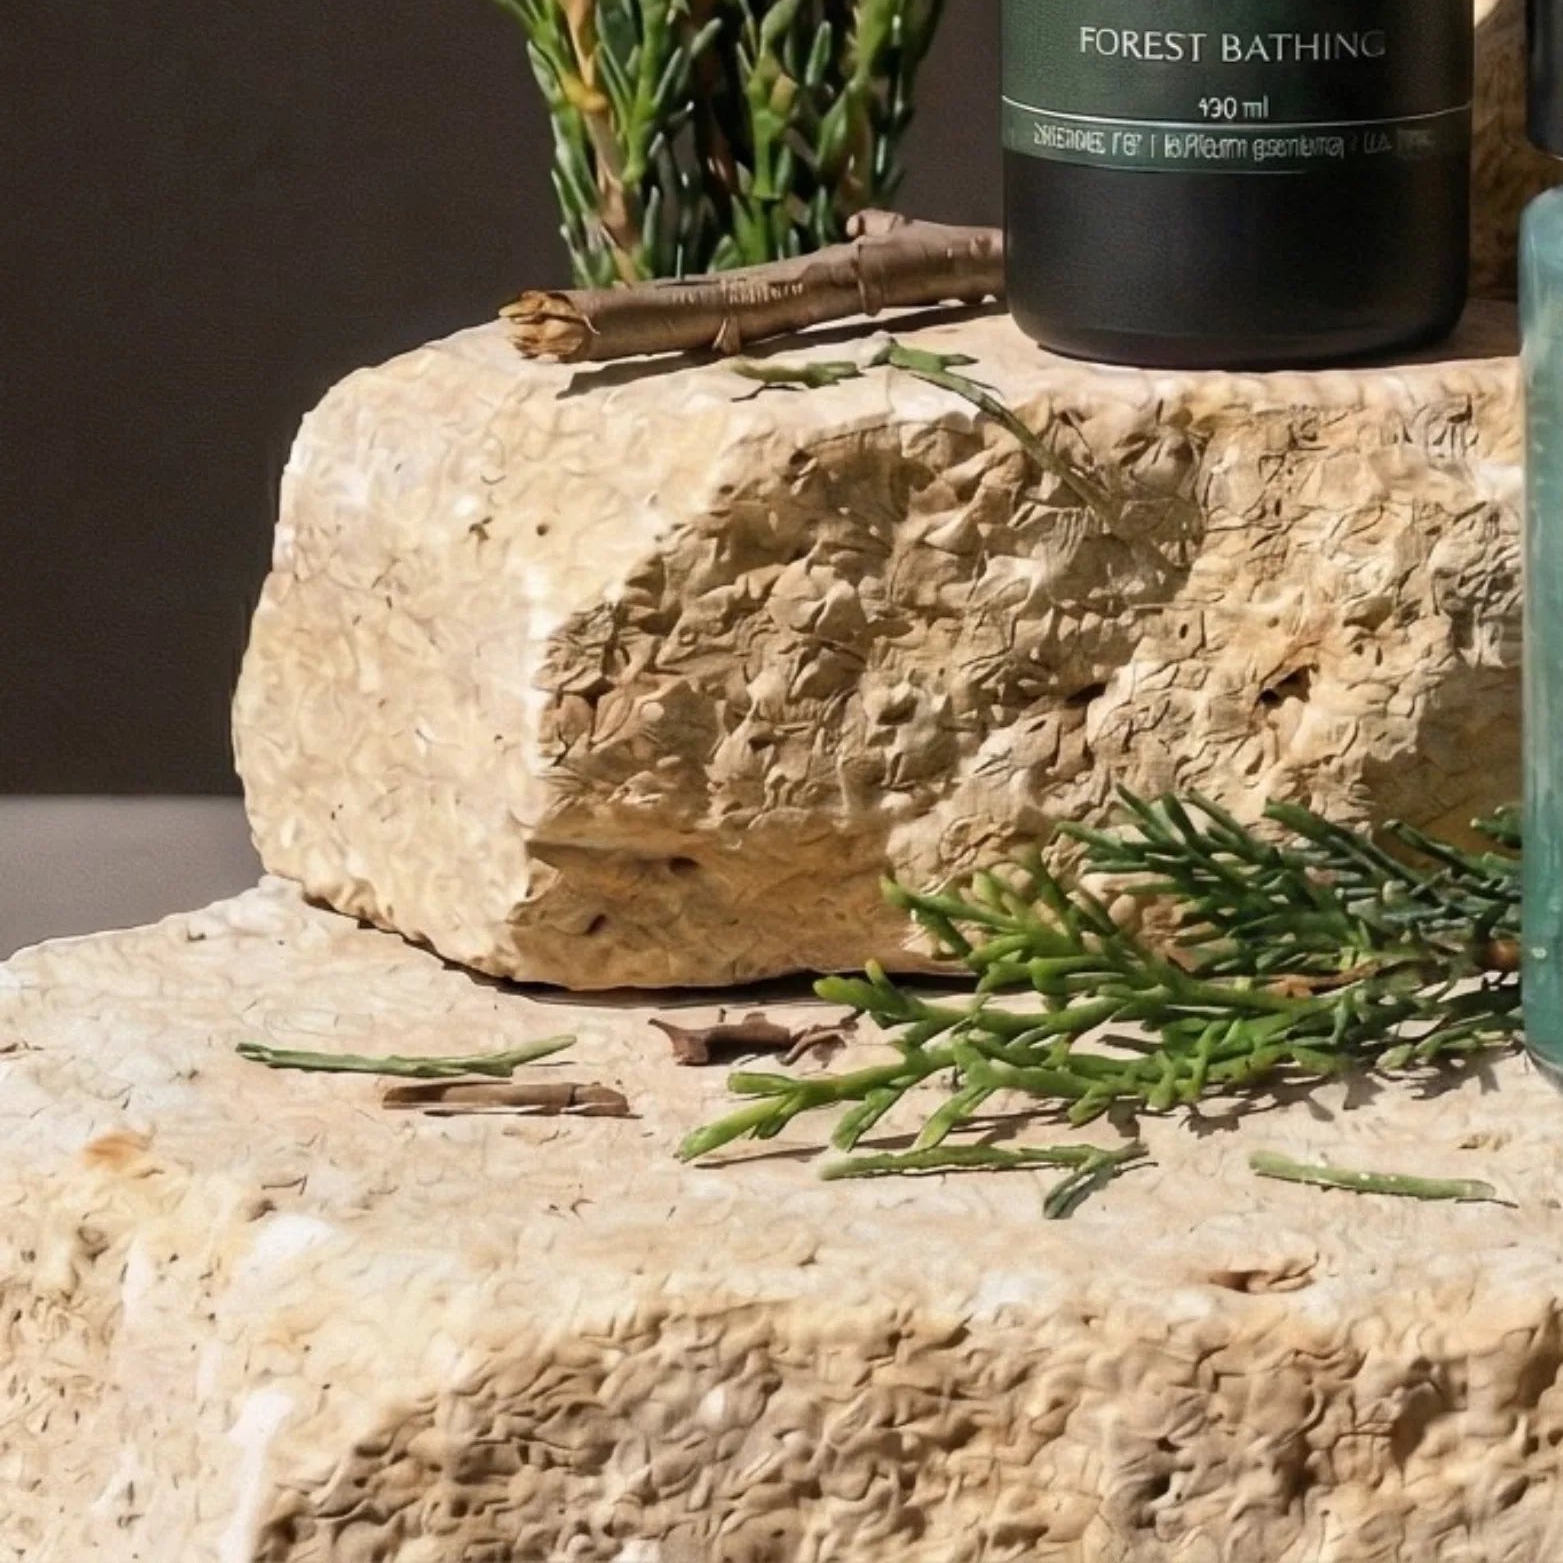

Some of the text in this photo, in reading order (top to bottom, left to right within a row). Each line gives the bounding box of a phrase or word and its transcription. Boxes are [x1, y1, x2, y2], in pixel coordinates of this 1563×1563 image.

[1080, 27, 1387, 63] FOREST BATHING
[1242, 95, 1269, 119] ml
